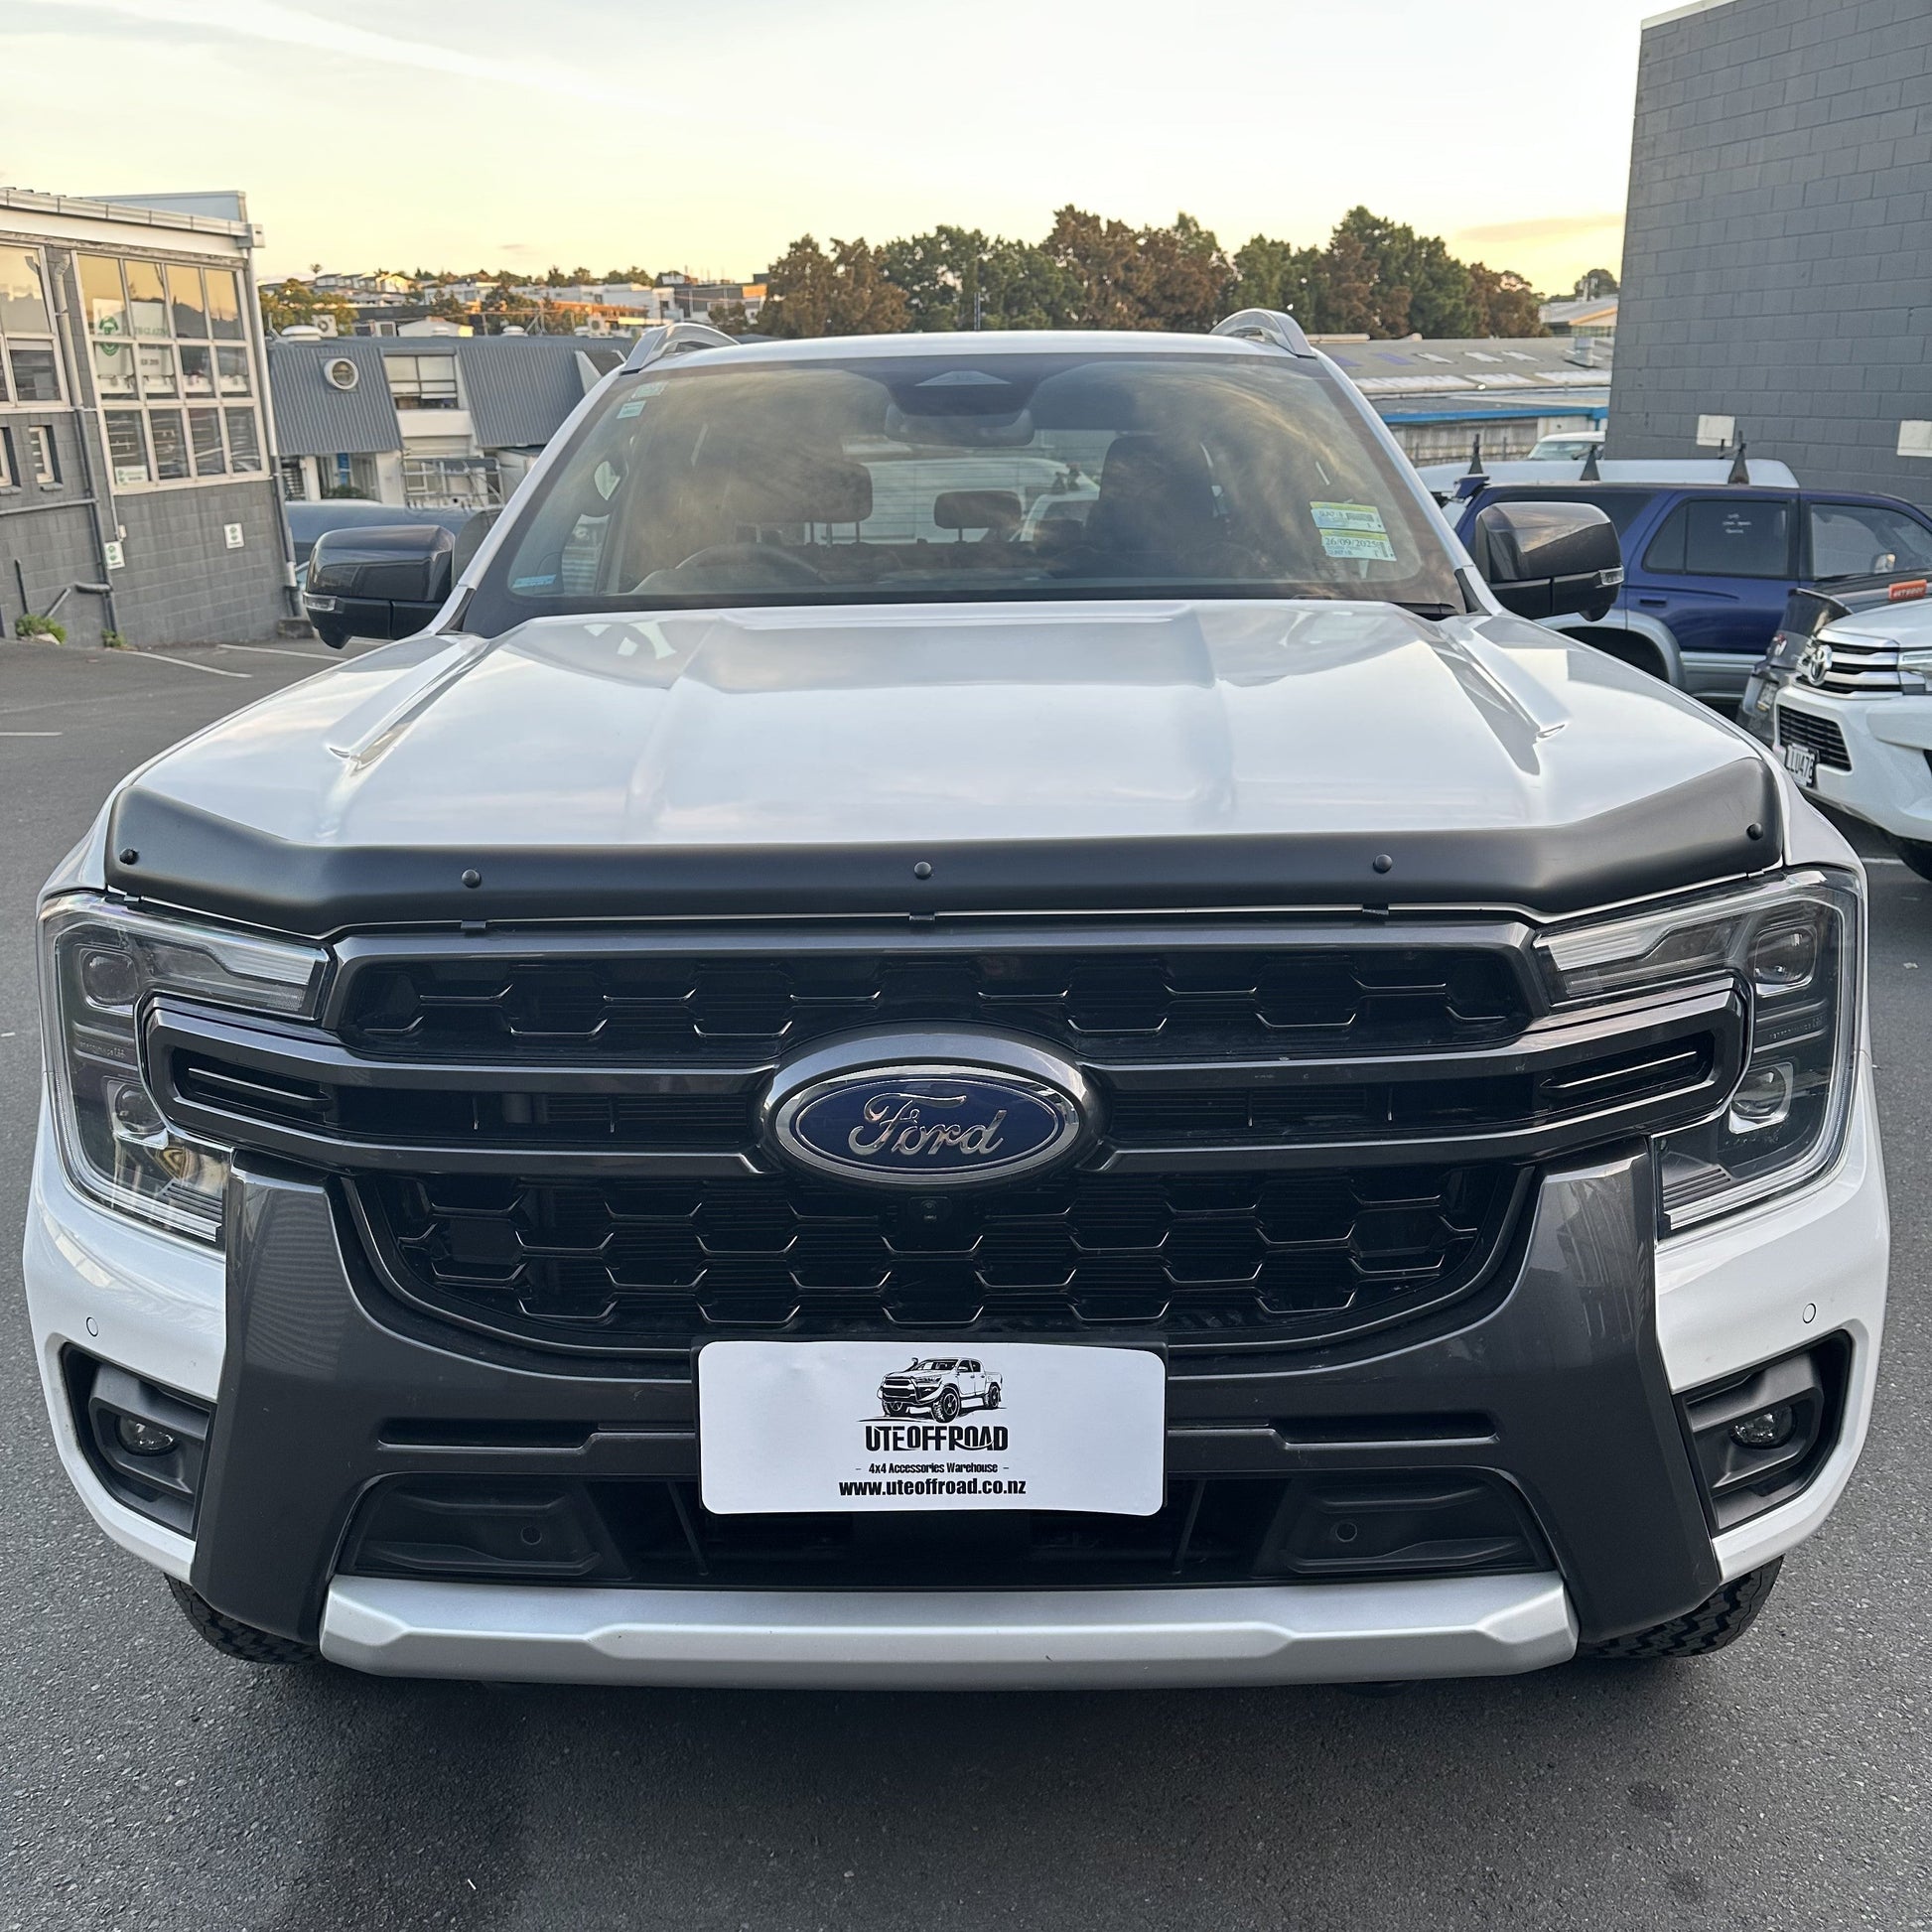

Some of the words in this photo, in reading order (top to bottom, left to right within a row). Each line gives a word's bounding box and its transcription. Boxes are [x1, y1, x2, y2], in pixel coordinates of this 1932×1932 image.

[1324, 537, 1376, 548] 26/09/2025
[848, 1093, 1007, 1156] Ford
[869, 1463, 887, 1473] 4x4
[889, 1462, 944, 1473] Accessories
[946, 1462, 998, 1473] Warehouse
[839, 1478, 1027, 1496] www.uteoffroad.co.nz
